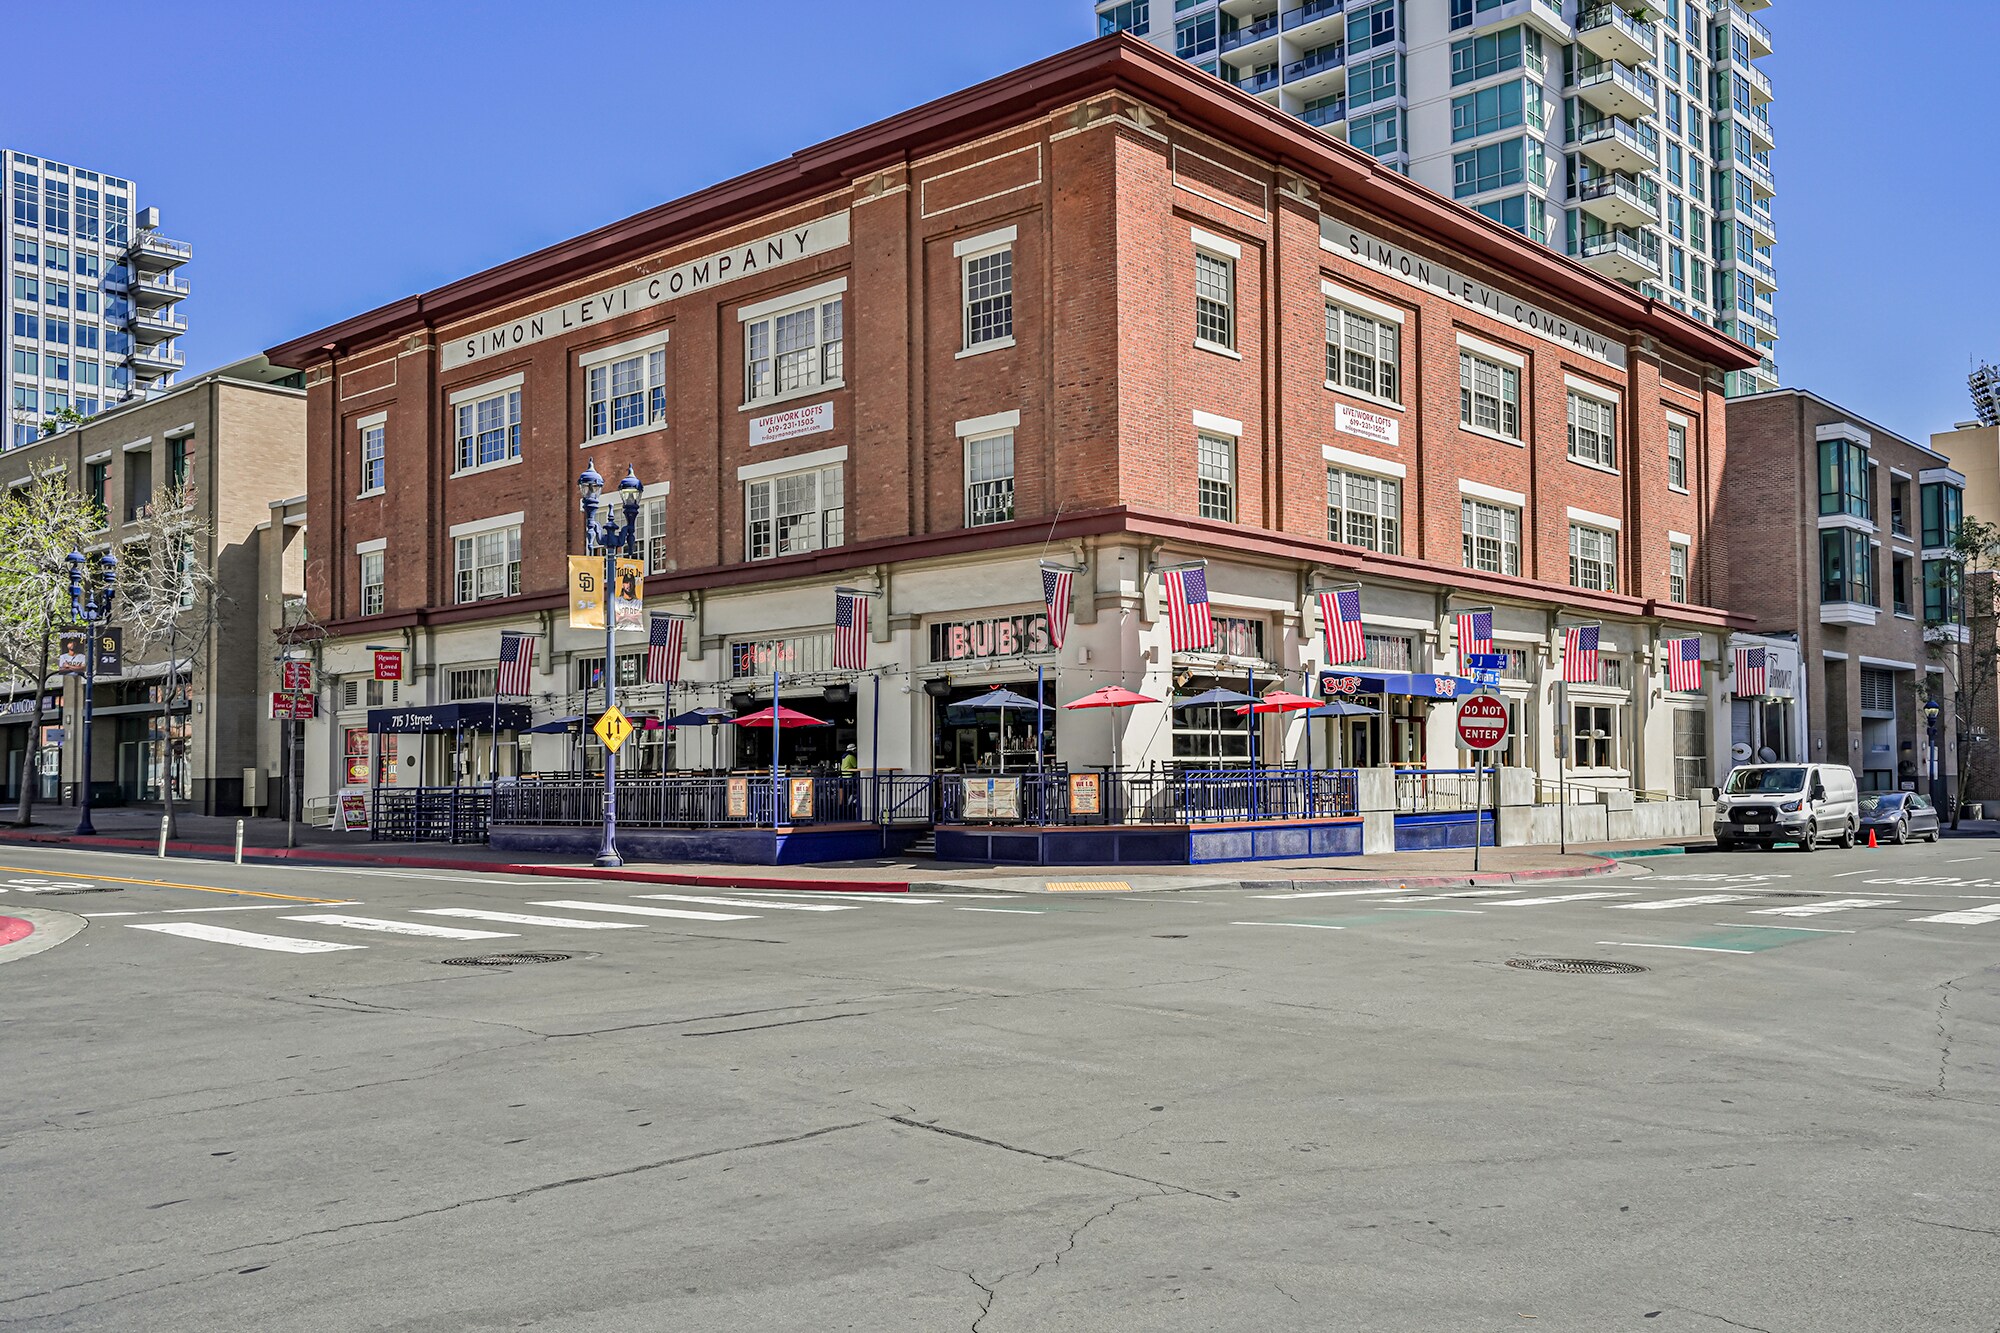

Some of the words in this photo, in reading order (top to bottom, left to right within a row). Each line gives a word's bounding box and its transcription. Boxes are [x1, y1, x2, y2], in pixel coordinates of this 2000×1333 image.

[467, 316, 543, 358] SIMON
[562, 289, 626, 328] LEVI
[648, 230, 809, 300] COMPANY
[1350, 234, 1430, 285] SIMON
[1447, 274, 1499, 315] LEVI
[1514, 304, 1607, 359] COMPANY
[759, 411, 799, 427] LIVE/WORK
[801, 406, 823, 418] LOFTS
[1342, 407, 1374, 423] LIVE/WORK
[1375, 415, 1391, 428] LOFTS
[948, 617, 1049, 660] BUB'S
[376, 654, 399, 662] Reunite
[1478, 656, 1483, 667] J
[1464, 705, 1479, 715] DO
[1482, 705, 1502, 716] NOT
[392, 715, 404, 728] 715
[405, 714, 410, 728] J
[410, 713, 433, 726] Street
[1465, 729, 1498, 740] ENTER
